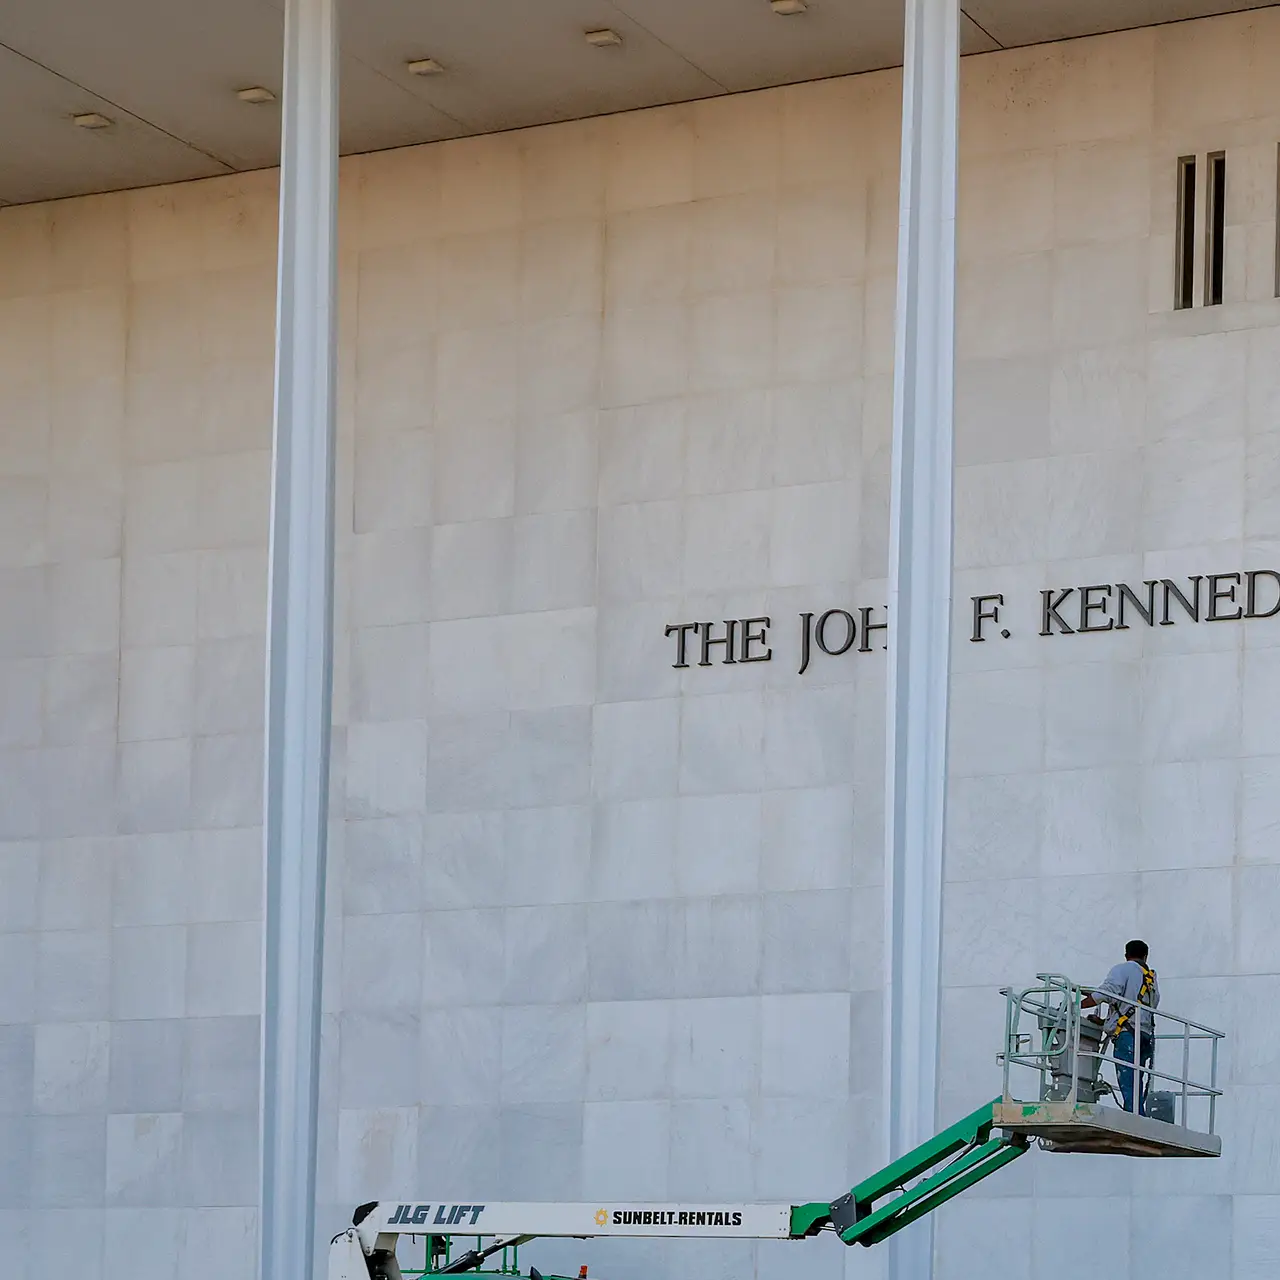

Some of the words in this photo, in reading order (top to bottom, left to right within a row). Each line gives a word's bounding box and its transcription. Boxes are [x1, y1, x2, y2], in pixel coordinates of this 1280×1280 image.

[665, 617, 772, 668] THE
[799, 607, 888, 674] JOH
[970, 594, 1010, 642] F.
[387, 1205, 430, 1224] JLG
[433, 1205, 485, 1225] LIFT
[613, 1211, 675, 1225] SUNBELT
[679, 1211, 742, 1226] RENTALS
